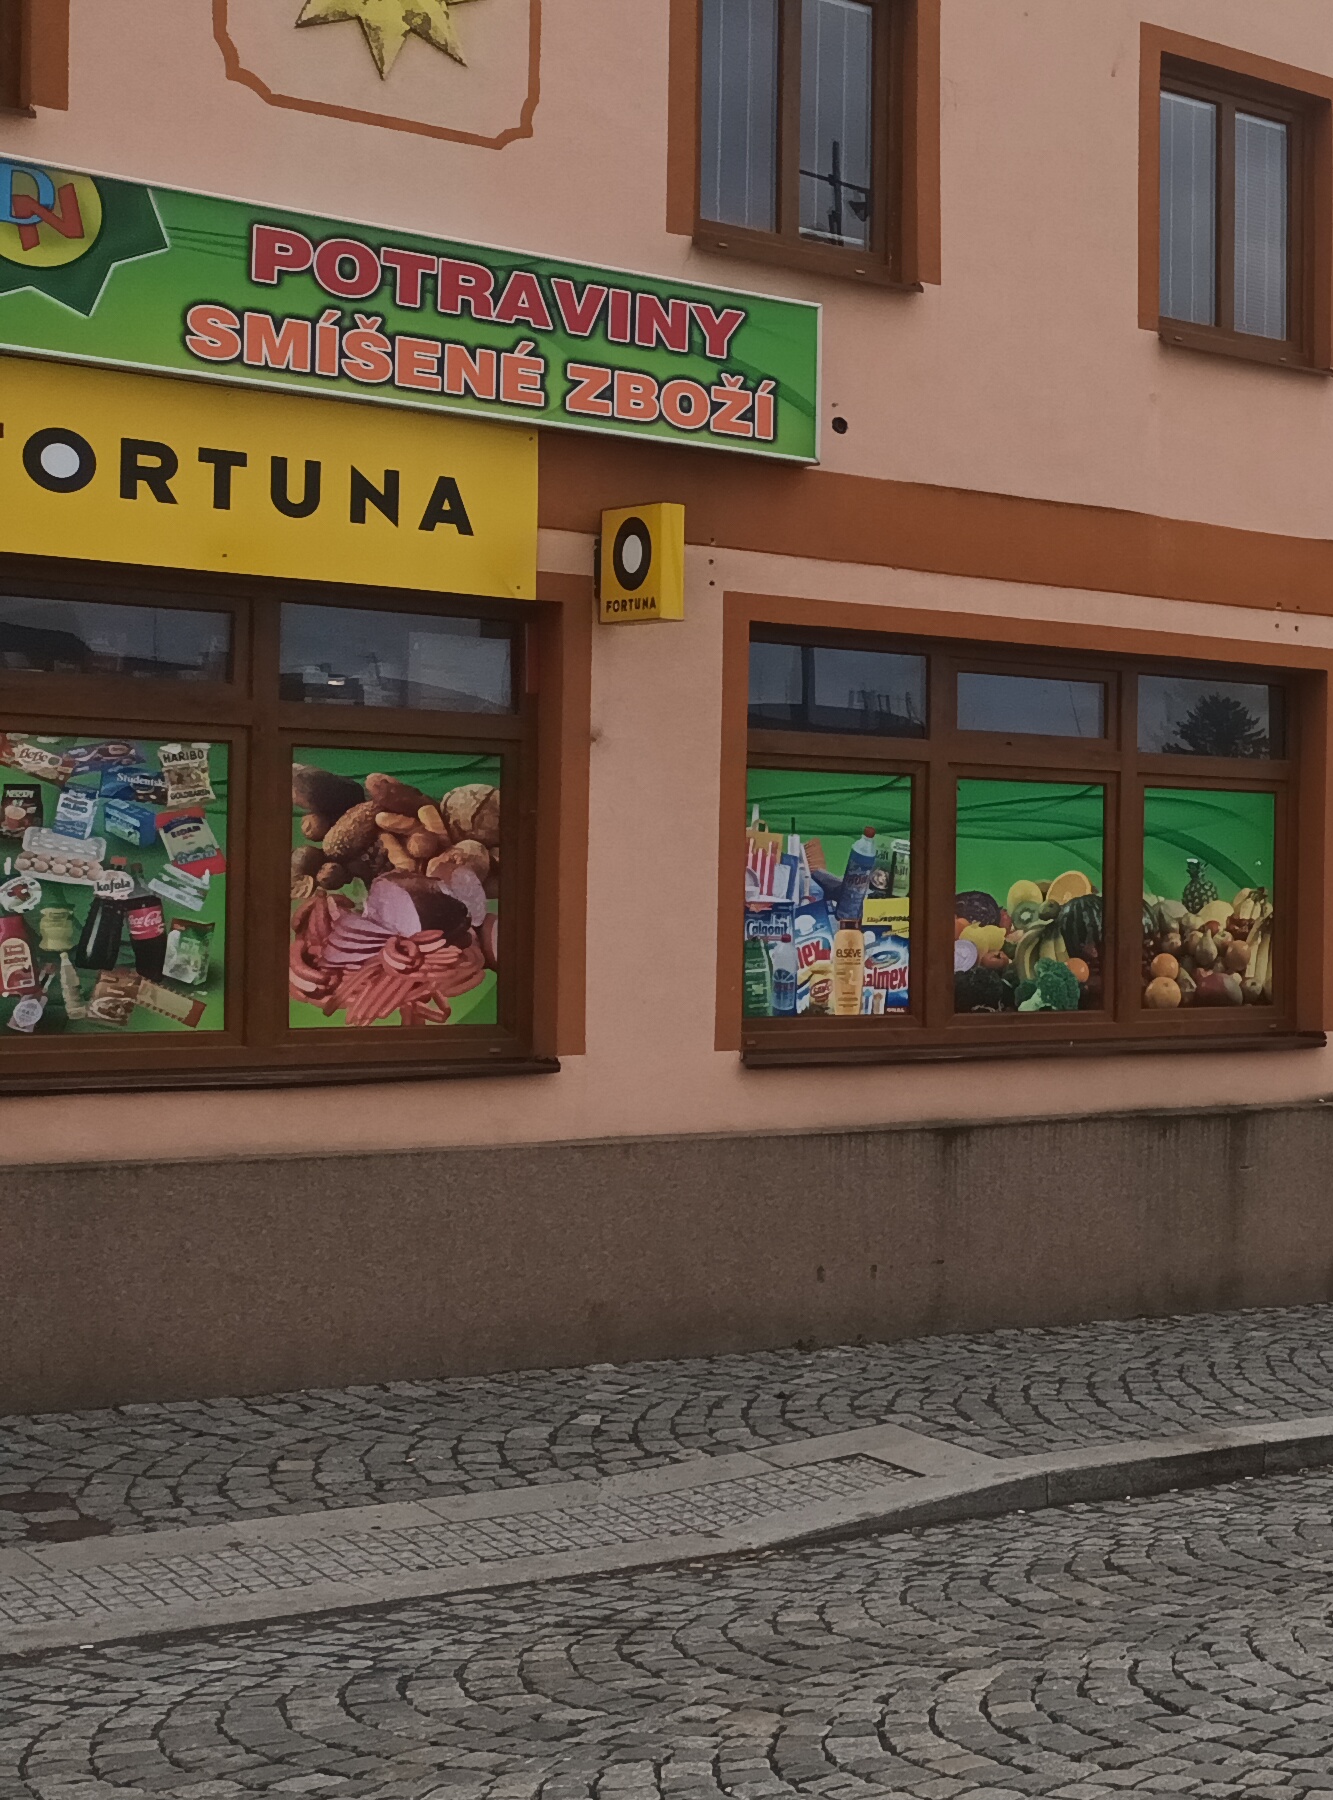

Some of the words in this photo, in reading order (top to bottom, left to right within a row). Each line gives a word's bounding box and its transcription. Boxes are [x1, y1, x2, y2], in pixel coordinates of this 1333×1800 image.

[249, 223, 745, 359] POTRAVINY
[185, 304, 548, 407] SMÍŠENÉ
[564, 361, 777, 440] ZBOŽÍ
[0, 422, 474, 537] ORTUNA
[605, 597, 658, 613] FORTUNA
[163, 749, 204, 763] HARIBO
[117, 771, 166, 788] Studentsk
[96, 877, 131, 893] kofola
